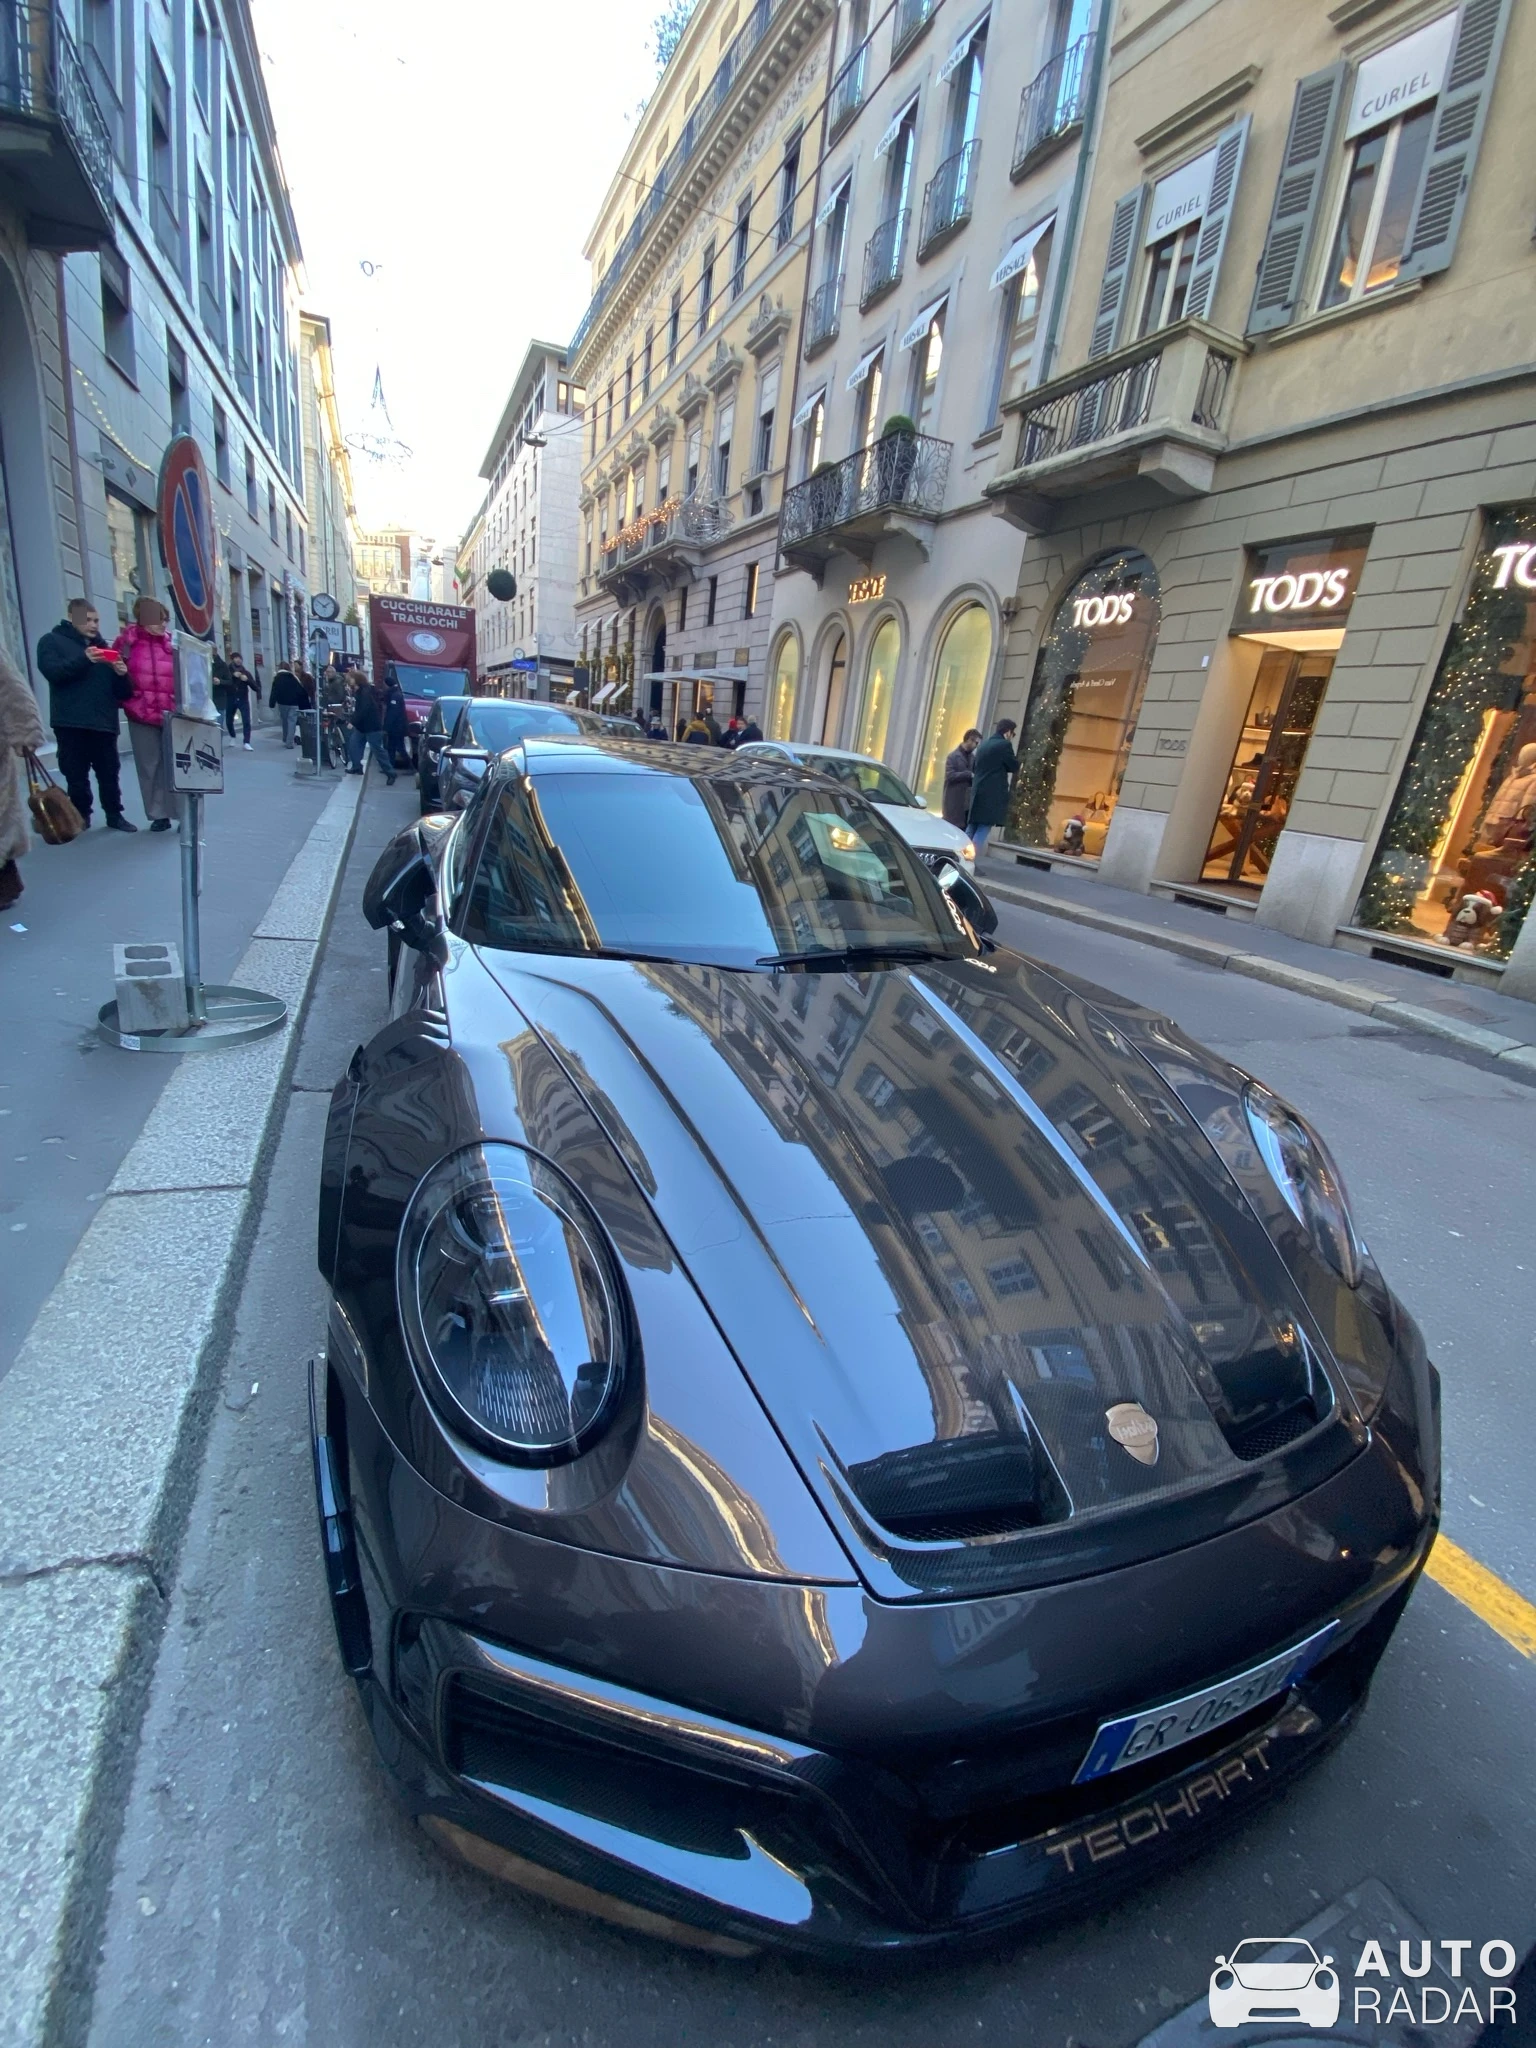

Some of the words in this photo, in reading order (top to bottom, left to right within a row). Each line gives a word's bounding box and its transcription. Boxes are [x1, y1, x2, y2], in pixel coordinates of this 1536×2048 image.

[1361, 72, 1430, 119] CURIEL
[1156, 195, 1203, 231] CURIEL
[995, 251, 1026, 283] VERSACE
[1249, 568, 1349, 613] TOD'S
[380, 600, 467, 619] CUCCHIARALE
[391, 612, 458, 629] TRASLOCHI
[1072, 592, 1136, 628] TOD'S
[1046, 1738, 1270, 1873] TECHART
